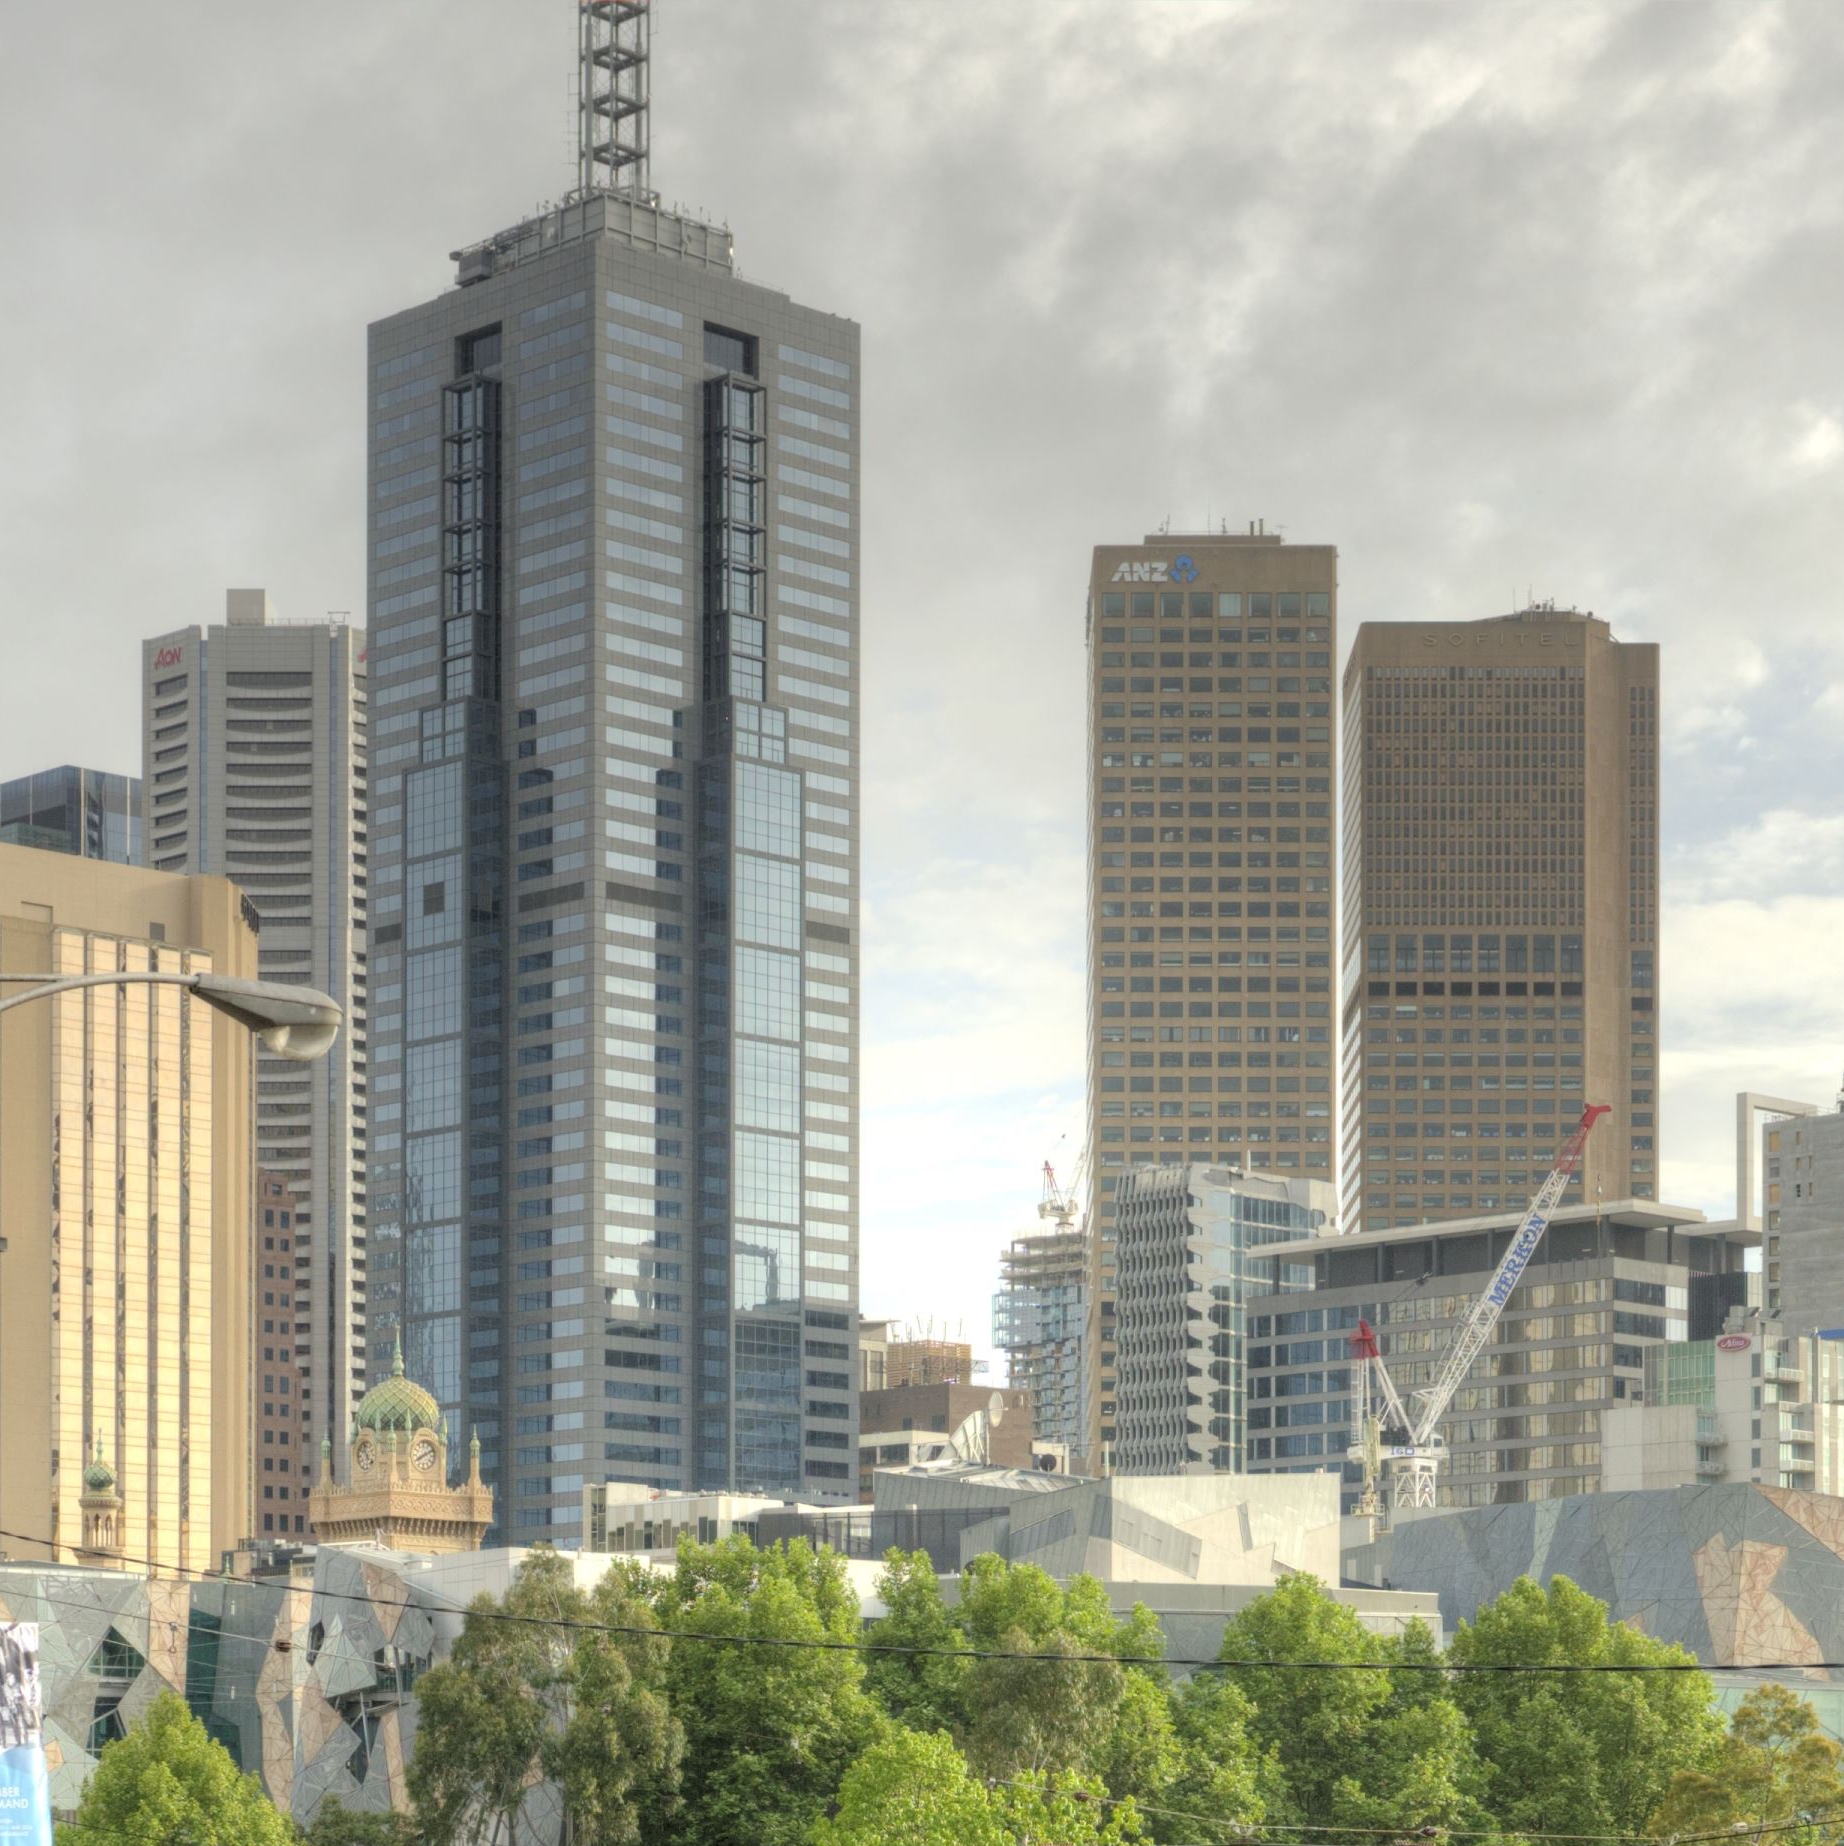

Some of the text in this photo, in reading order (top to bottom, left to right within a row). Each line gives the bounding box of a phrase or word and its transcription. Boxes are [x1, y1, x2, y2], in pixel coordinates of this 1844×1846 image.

[1111, 562, 1168, 582] ANZ
[1422, 632, 1579, 647] SOFITEL
[1488, 1212, 1546, 1306] MERKON
